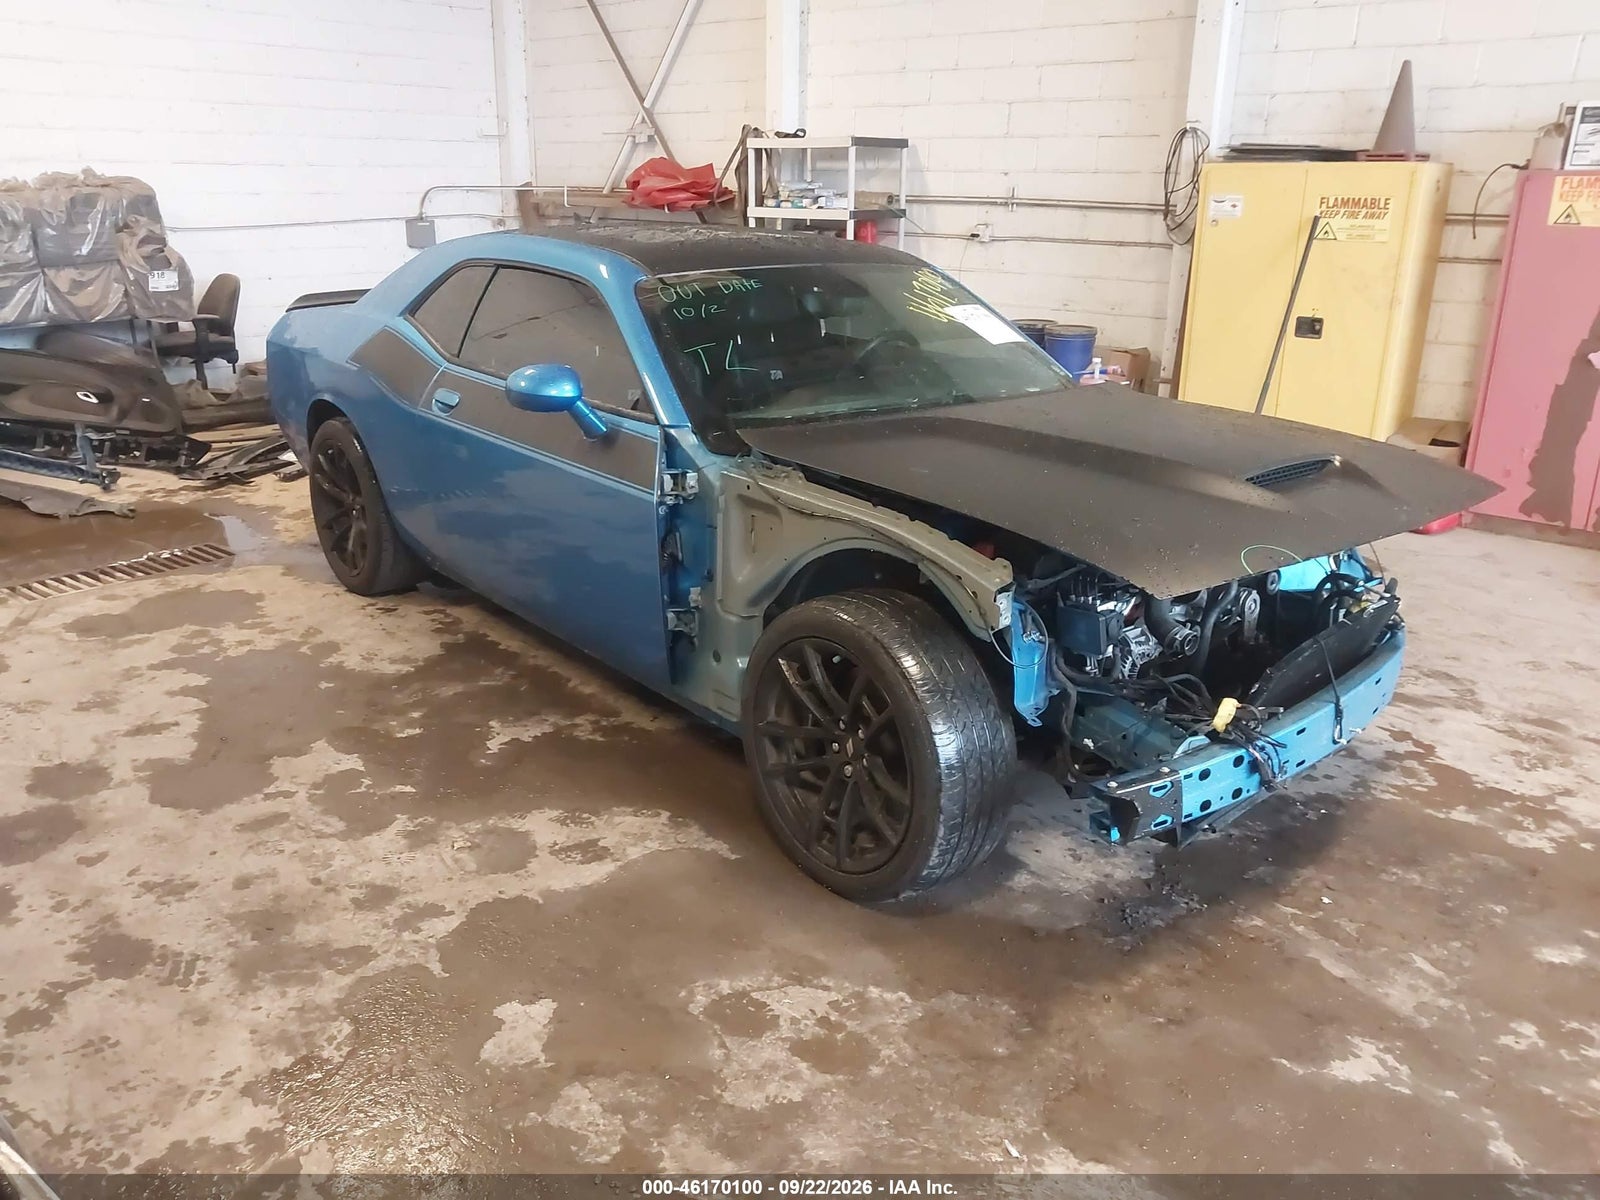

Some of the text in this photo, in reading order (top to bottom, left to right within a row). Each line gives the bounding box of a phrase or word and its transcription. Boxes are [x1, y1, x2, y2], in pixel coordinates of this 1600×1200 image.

[1319, 197, 1391, 210] FLAMMABLE
[1319, 210, 1388, 220] KEEP FIRE AWAY
[657, 282, 706, 303] OUT
